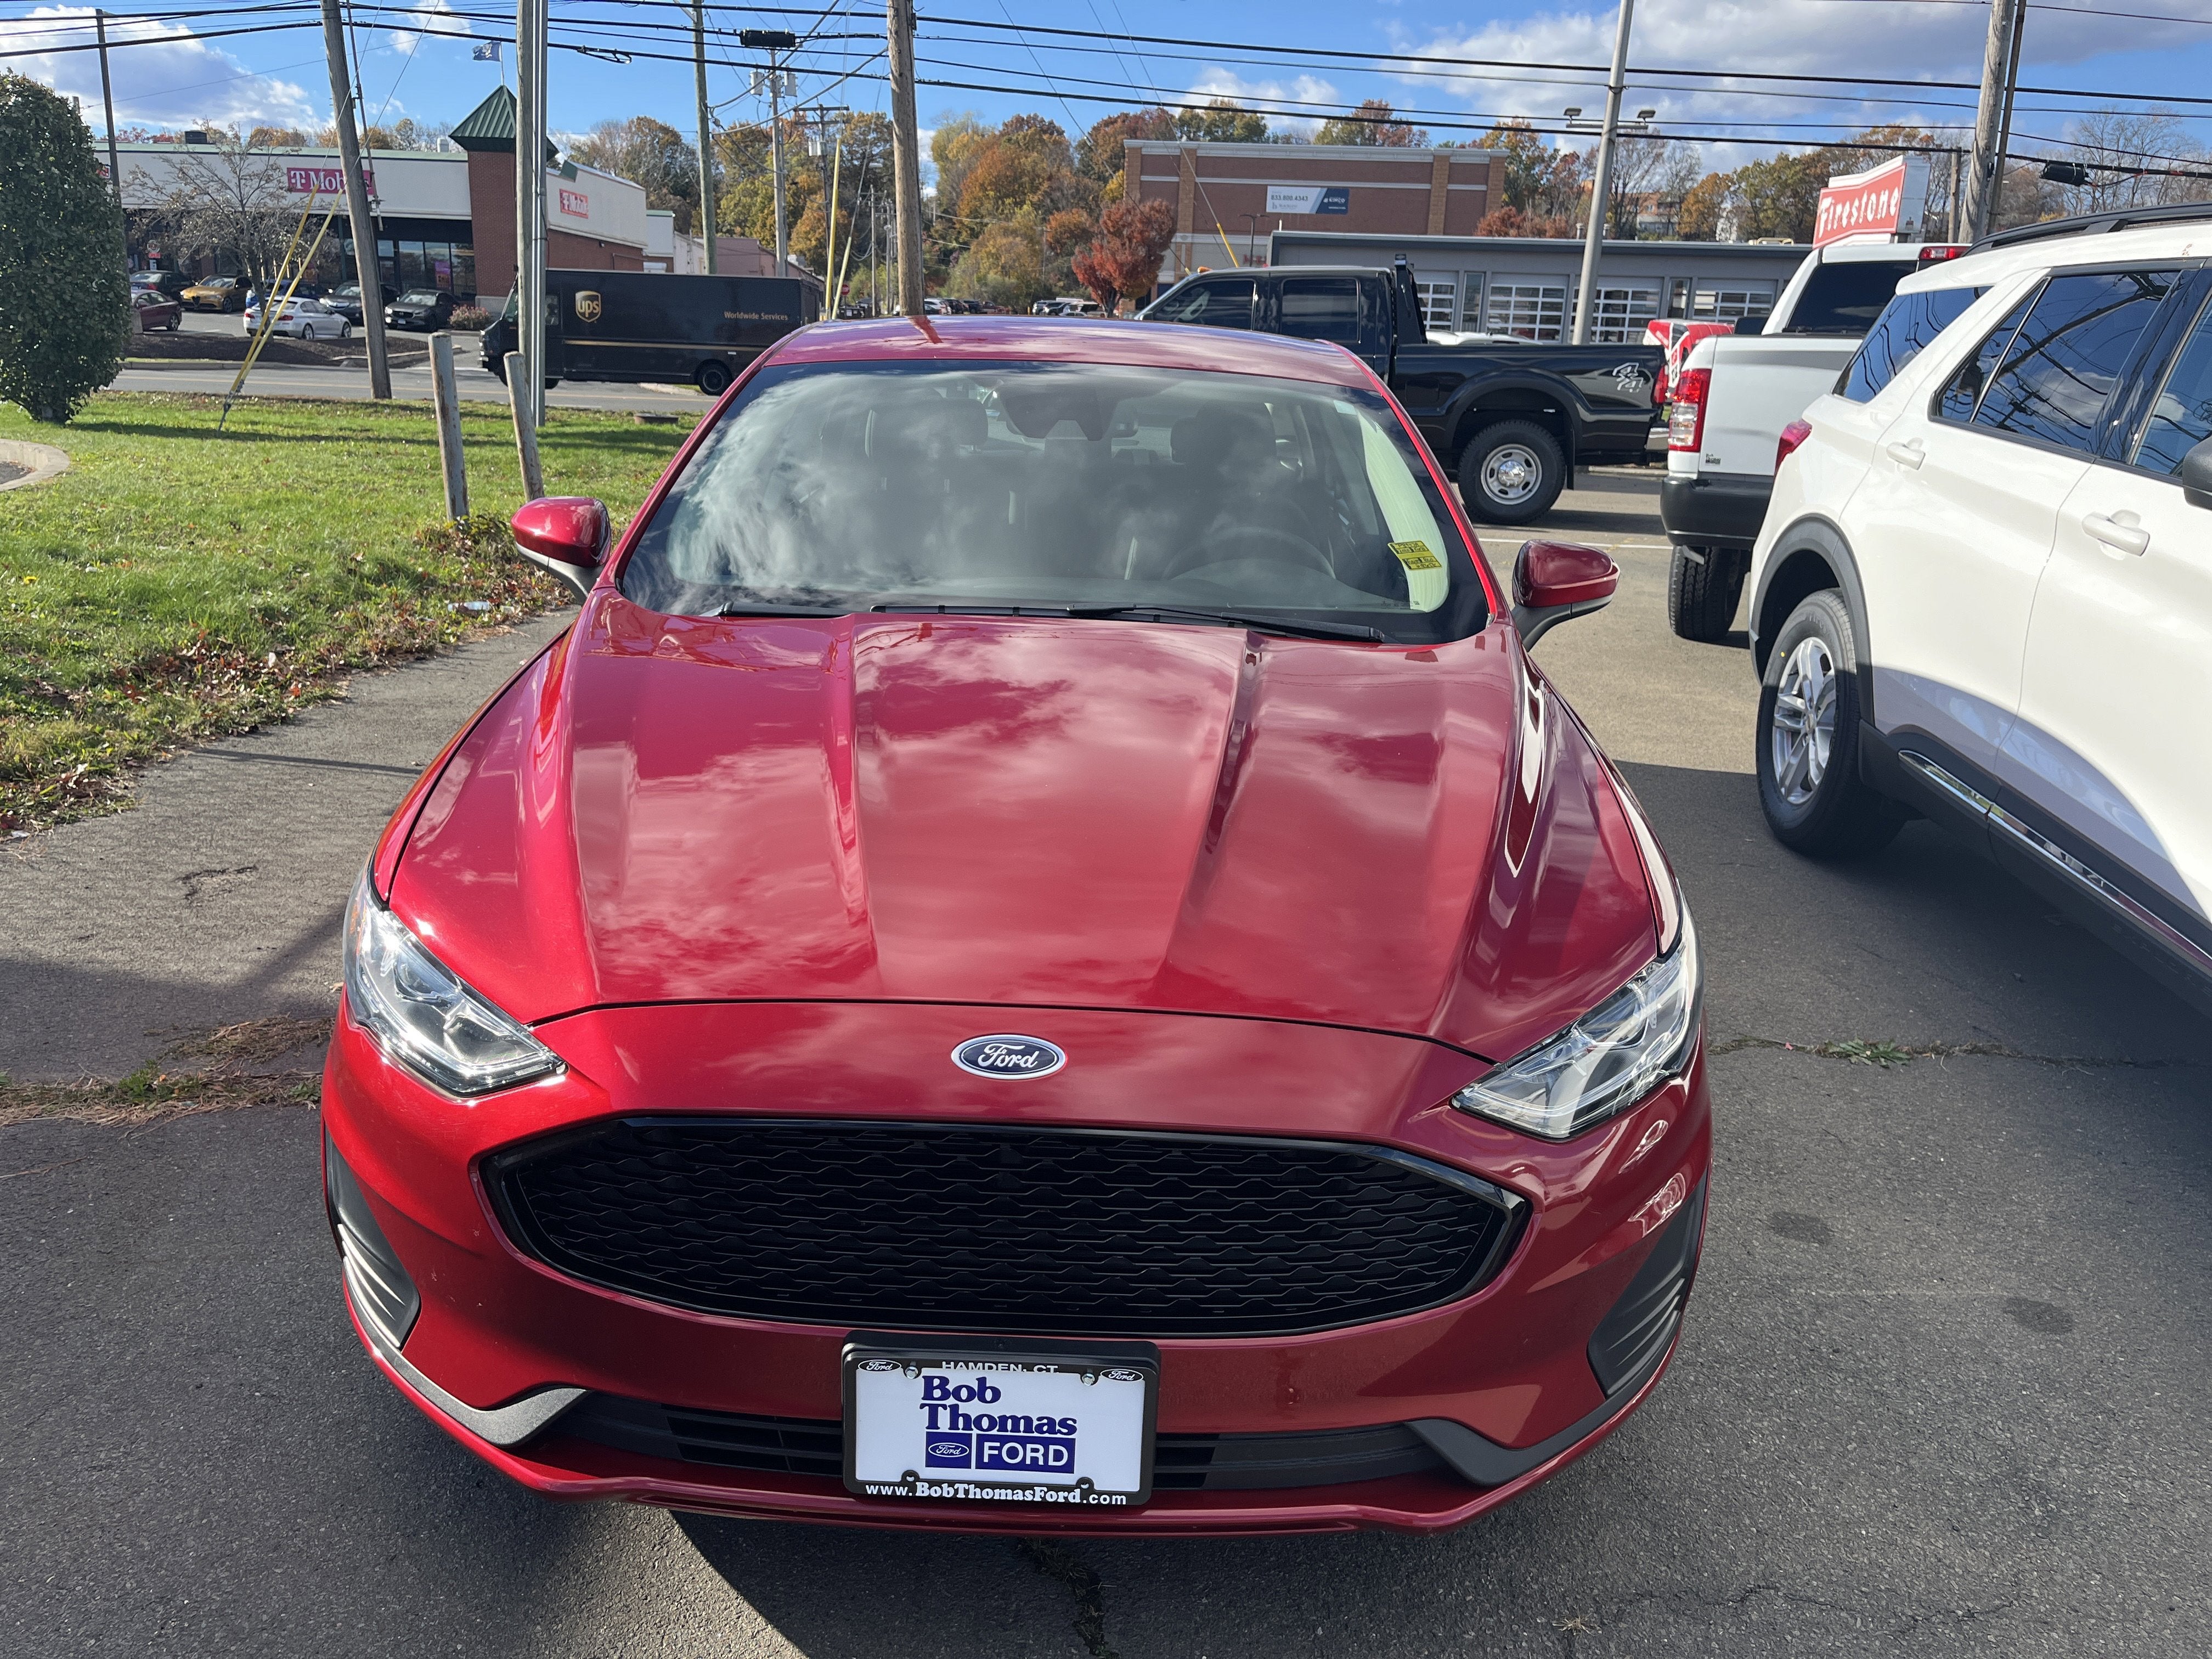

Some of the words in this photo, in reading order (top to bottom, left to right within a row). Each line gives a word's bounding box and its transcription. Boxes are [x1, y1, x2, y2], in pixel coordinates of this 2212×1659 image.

[1819, 187, 1899, 238] Firestone
[578, 300, 599, 317] ups
[724, 311, 759, 319] Worldwide
[761, 312, 788, 320] Services
[978, 1043, 1040, 1068] Ford
[866, 1361, 893, 1371] Ford
[1108, 1370, 1135, 1381] Ford
[922, 1375, 1001, 1404] Bob
[919, 1403, 1077, 1436] Thomas
[936, 1444, 961, 1455] Ford
[983, 1442, 1068, 1466] FORD
[865, 1482, 1127, 1505] www.BobThomasFord.com
